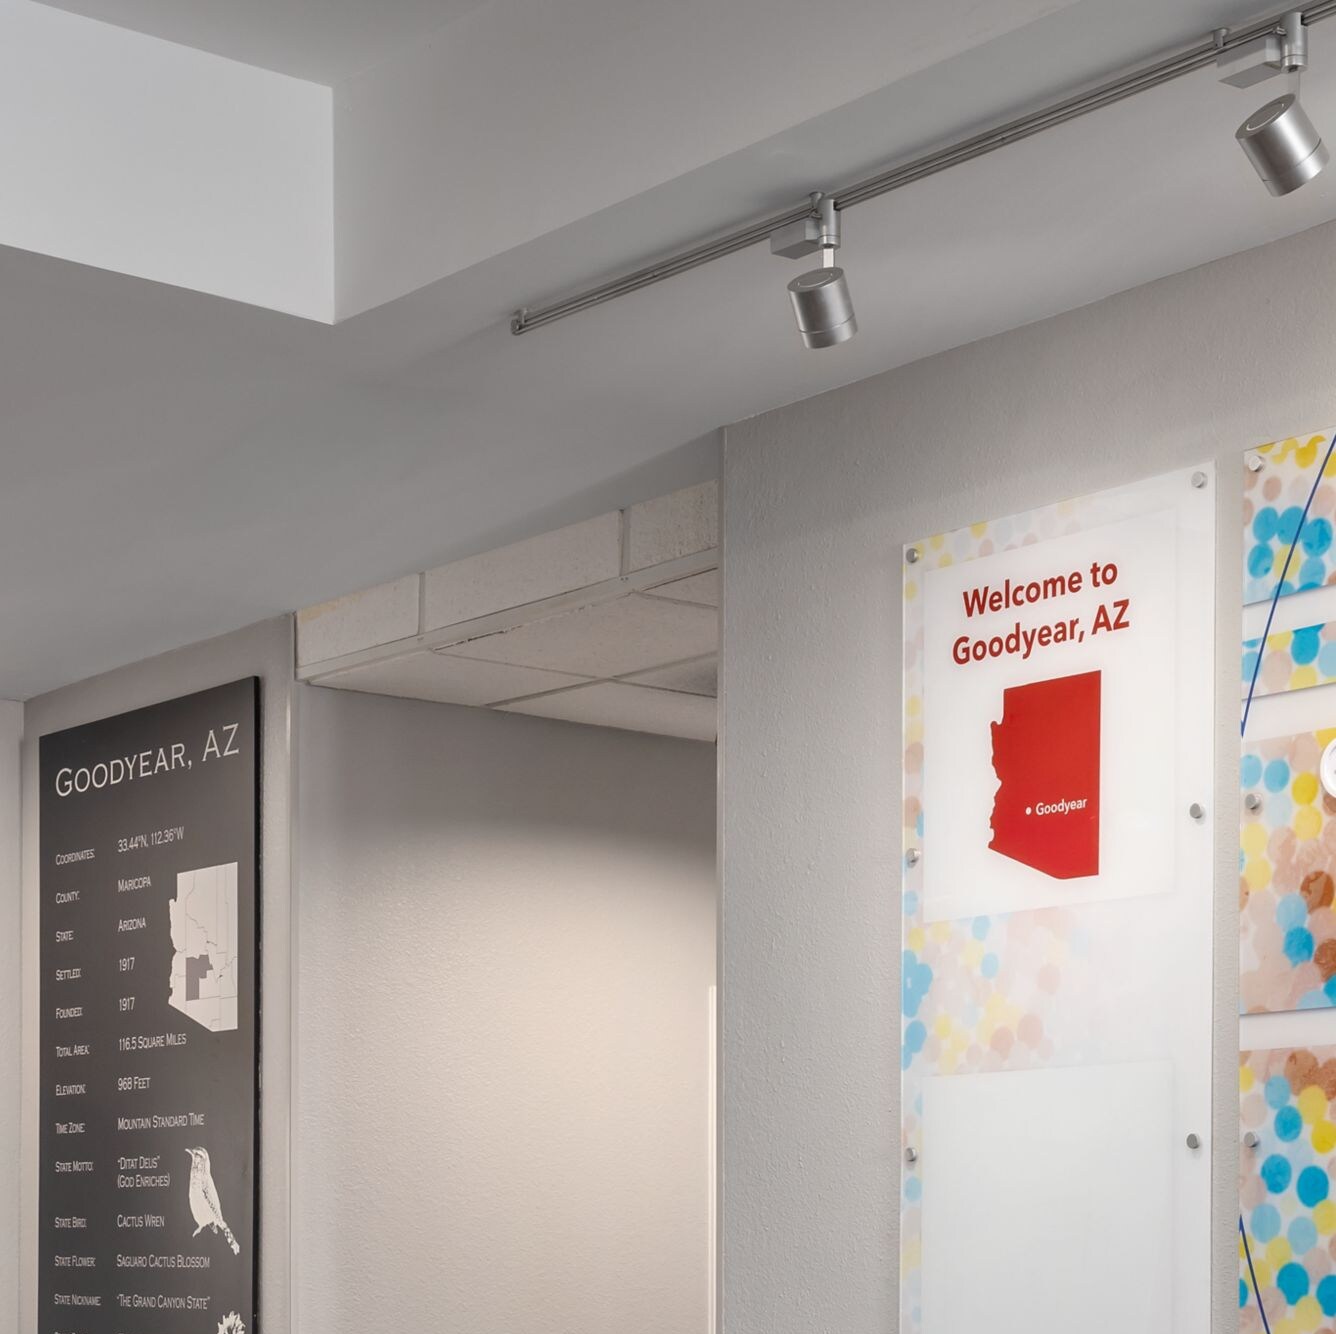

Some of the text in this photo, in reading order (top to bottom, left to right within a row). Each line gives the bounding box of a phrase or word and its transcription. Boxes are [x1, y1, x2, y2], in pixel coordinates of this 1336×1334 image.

[963, 562, 1118, 617] Welcome to
[952, 599, 1131, 665] Goodyear, AZ
[56, 723, 239, 796] GOODYEAR, AZ
[1036, 797, 1087, 816] Goodyear
[118, 876, 151, 892] MARICOPA
[118, 918, 146, 932] ARIZONA
[120, 957, 135, 971] 1917
[120, 997, 135, 1011] 1917
[119, 1033, 186, 1050] 116.5 SQUARE MILES
[56, 1046, 72, 1057] TOTAL
[118, 1077, 150, 1091] 968 FEET
[56, 1123, 67, 1134] TIME
[118, 1113, 204, 1131] MOUNTAIN STANDARD TIME
[56, 1161, 72, 1172] STATE
[118, 1175, 170, 1188] (GOD ENRICHES)
[55, 1217, 71, 1228] STATE
[117, 1214, 164, 1227] CACTUS WREN
[55, 1256, 71, 1266] STATE
[117, 1255, 210, 1268] SAGUARO CACTUS BLOSSOM
[54, 1294, 70, 1305] STATE
[133, 1295, 156, 1308] GRAND
[158, 1295, 186, 1309] CANYON
